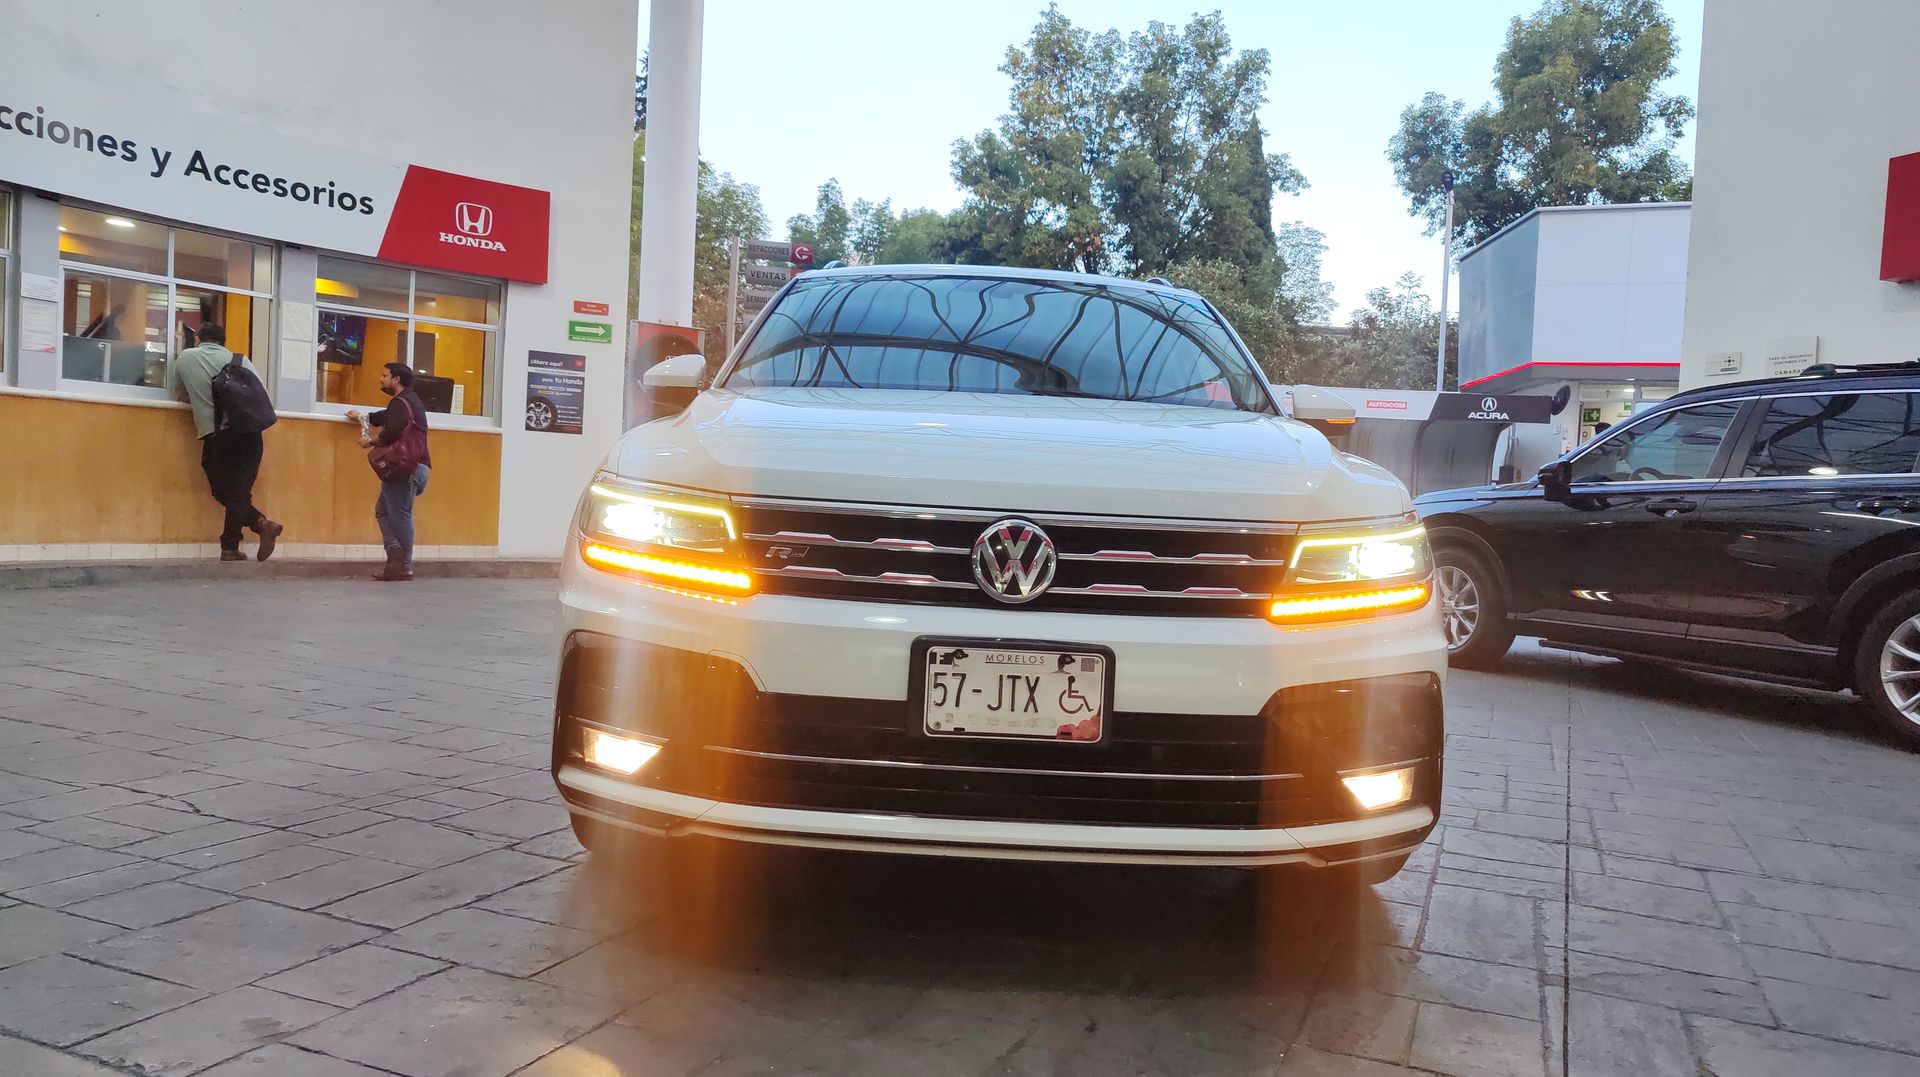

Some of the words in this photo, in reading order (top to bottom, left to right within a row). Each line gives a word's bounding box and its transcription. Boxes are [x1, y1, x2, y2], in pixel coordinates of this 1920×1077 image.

[150, 147, 172, 178] y
[183, 150, 375, 215] Accesorios
[438, 231, 507, 252] HONDA
[748, 244, 790, 256] REFACCIONES
[750, 270, 787, 281] VENTAS
[745, 294, 771, 304] SEMIN
[1774, 368, 1804, 376] CAMARA
[1367, 401, 1406, 409] AUTOCOM
[1467, 411, 1510, 420] ACURA
[985, 654, 1045, 664] MORELOS
[933, 671, 1040, 713] 57-JTX
